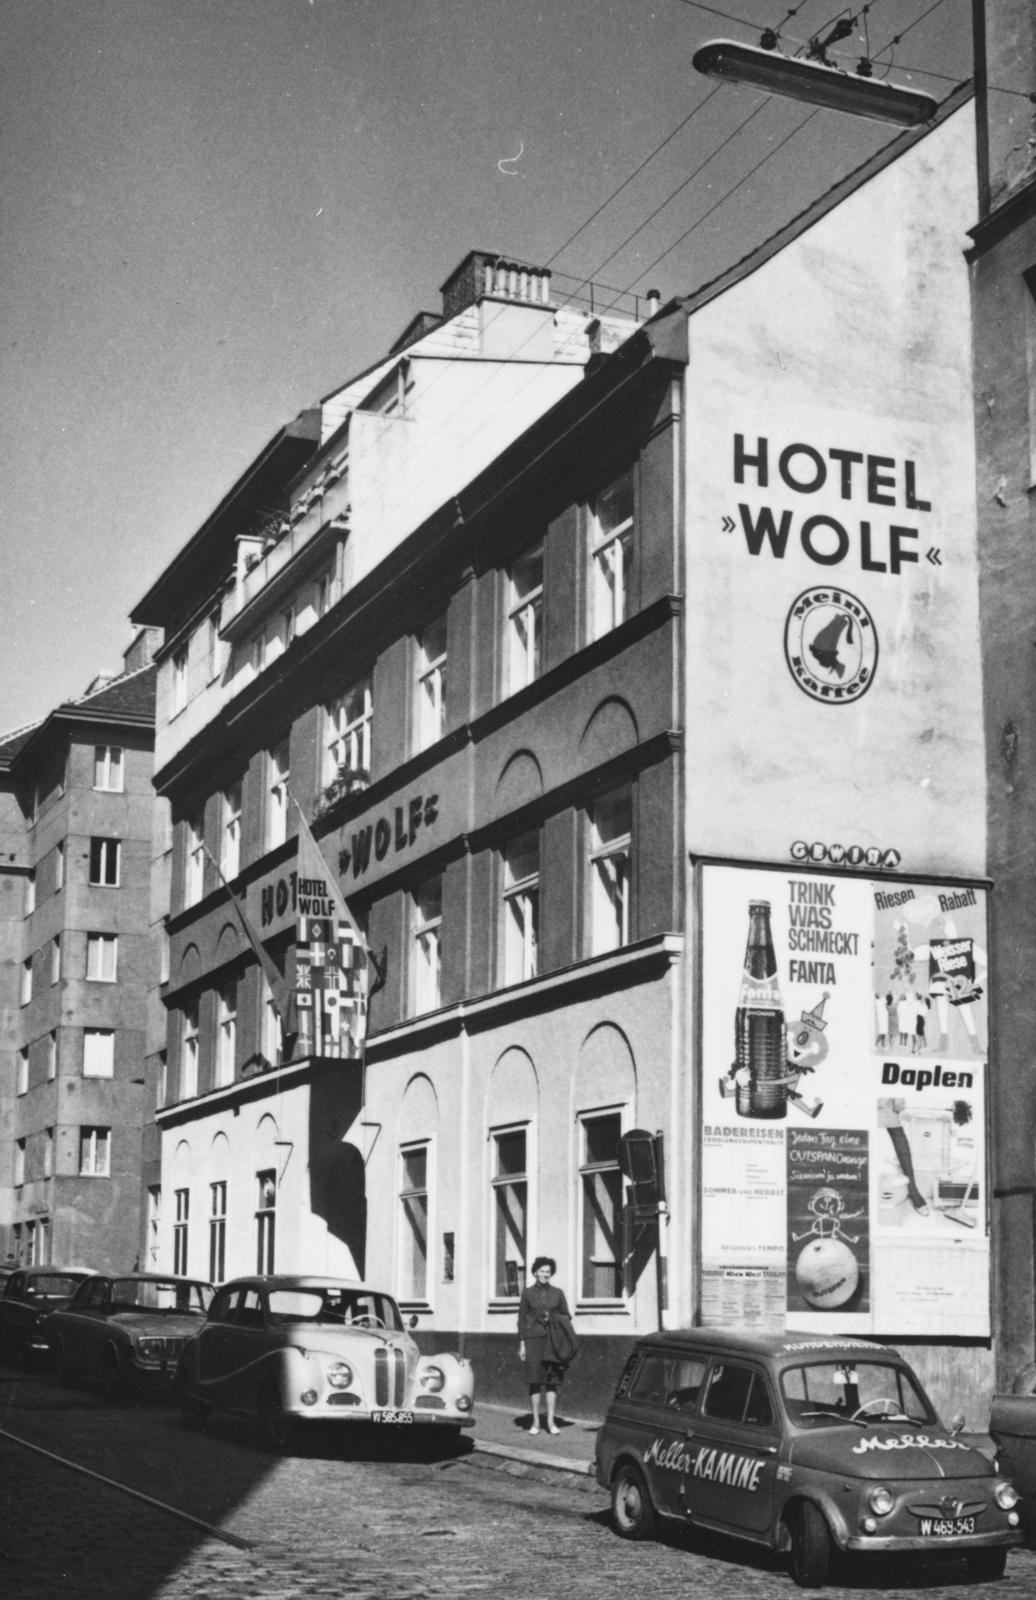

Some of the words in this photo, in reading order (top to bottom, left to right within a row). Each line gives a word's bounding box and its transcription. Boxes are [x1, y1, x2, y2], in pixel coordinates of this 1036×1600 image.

[733, 432, 932, 512] HOTEL
[791, 655, 870, 698] Kaffee
[298, 878, 328, 898] HOTEL
[787, 880, 836, 906] TRINK
[874, 888, 916, 911] Riesen
[938, 887, 977, 912] Rabatt
[298, 897, 336, 917] WOLF
[788, 904, 832, 930] WAS
[788, 928, 860, 956] SCHMECKT
[789, 960, 836, 986] FANTA
[881, 1062, 974, 1091] Daplen
[704, 1125, 784, 1139] BADEREISEN
[852, 1434, 971, 1454] Meller
[920, 1519, 933, 1536] W
